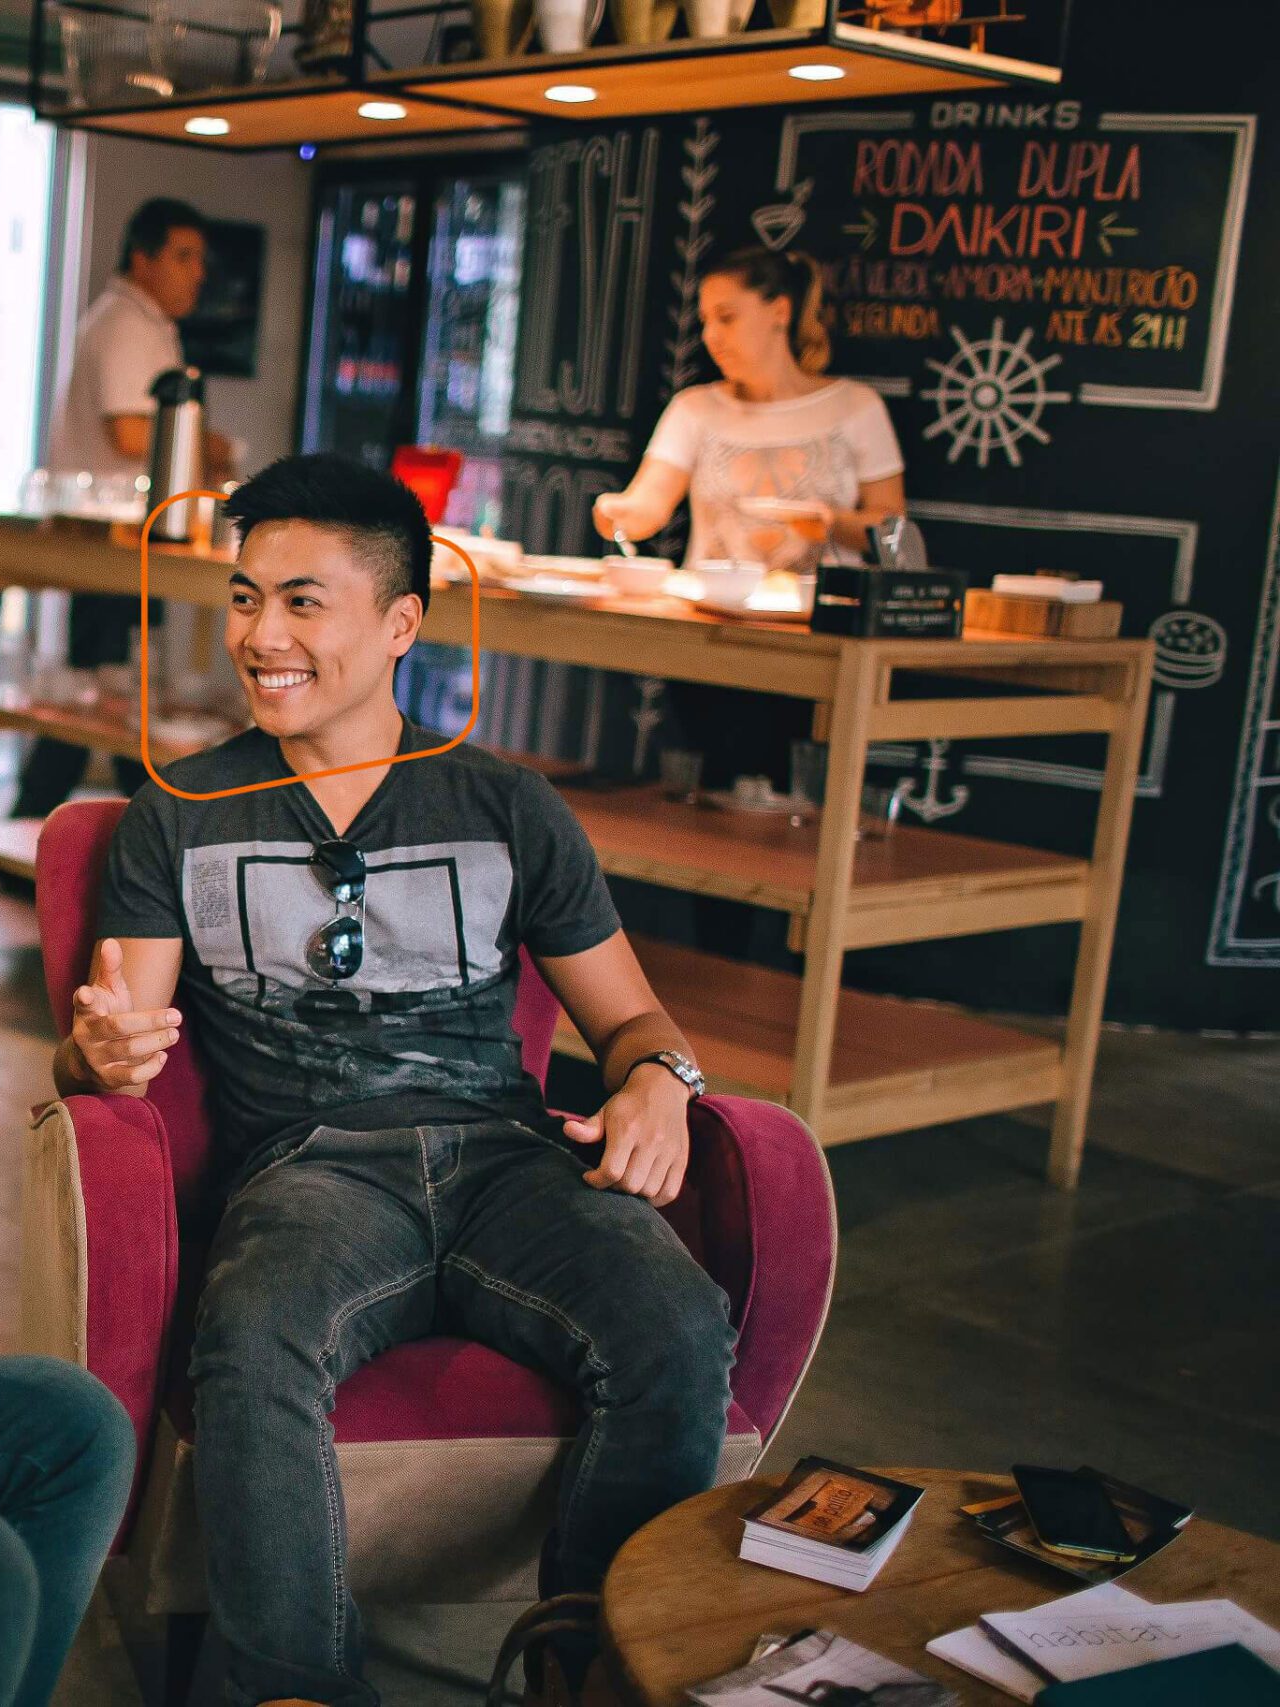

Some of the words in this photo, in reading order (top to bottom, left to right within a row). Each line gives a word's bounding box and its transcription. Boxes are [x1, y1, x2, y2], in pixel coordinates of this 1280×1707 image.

[930, 100, 1082, 131] DRINKS
[853, 138, 983, 198] RODADA
[1018, 140, 1141, 201] DUPLA
[889, 202, 1087, 260] DAIKIRI
[1017, 1621, 1181, 1649] habitat
